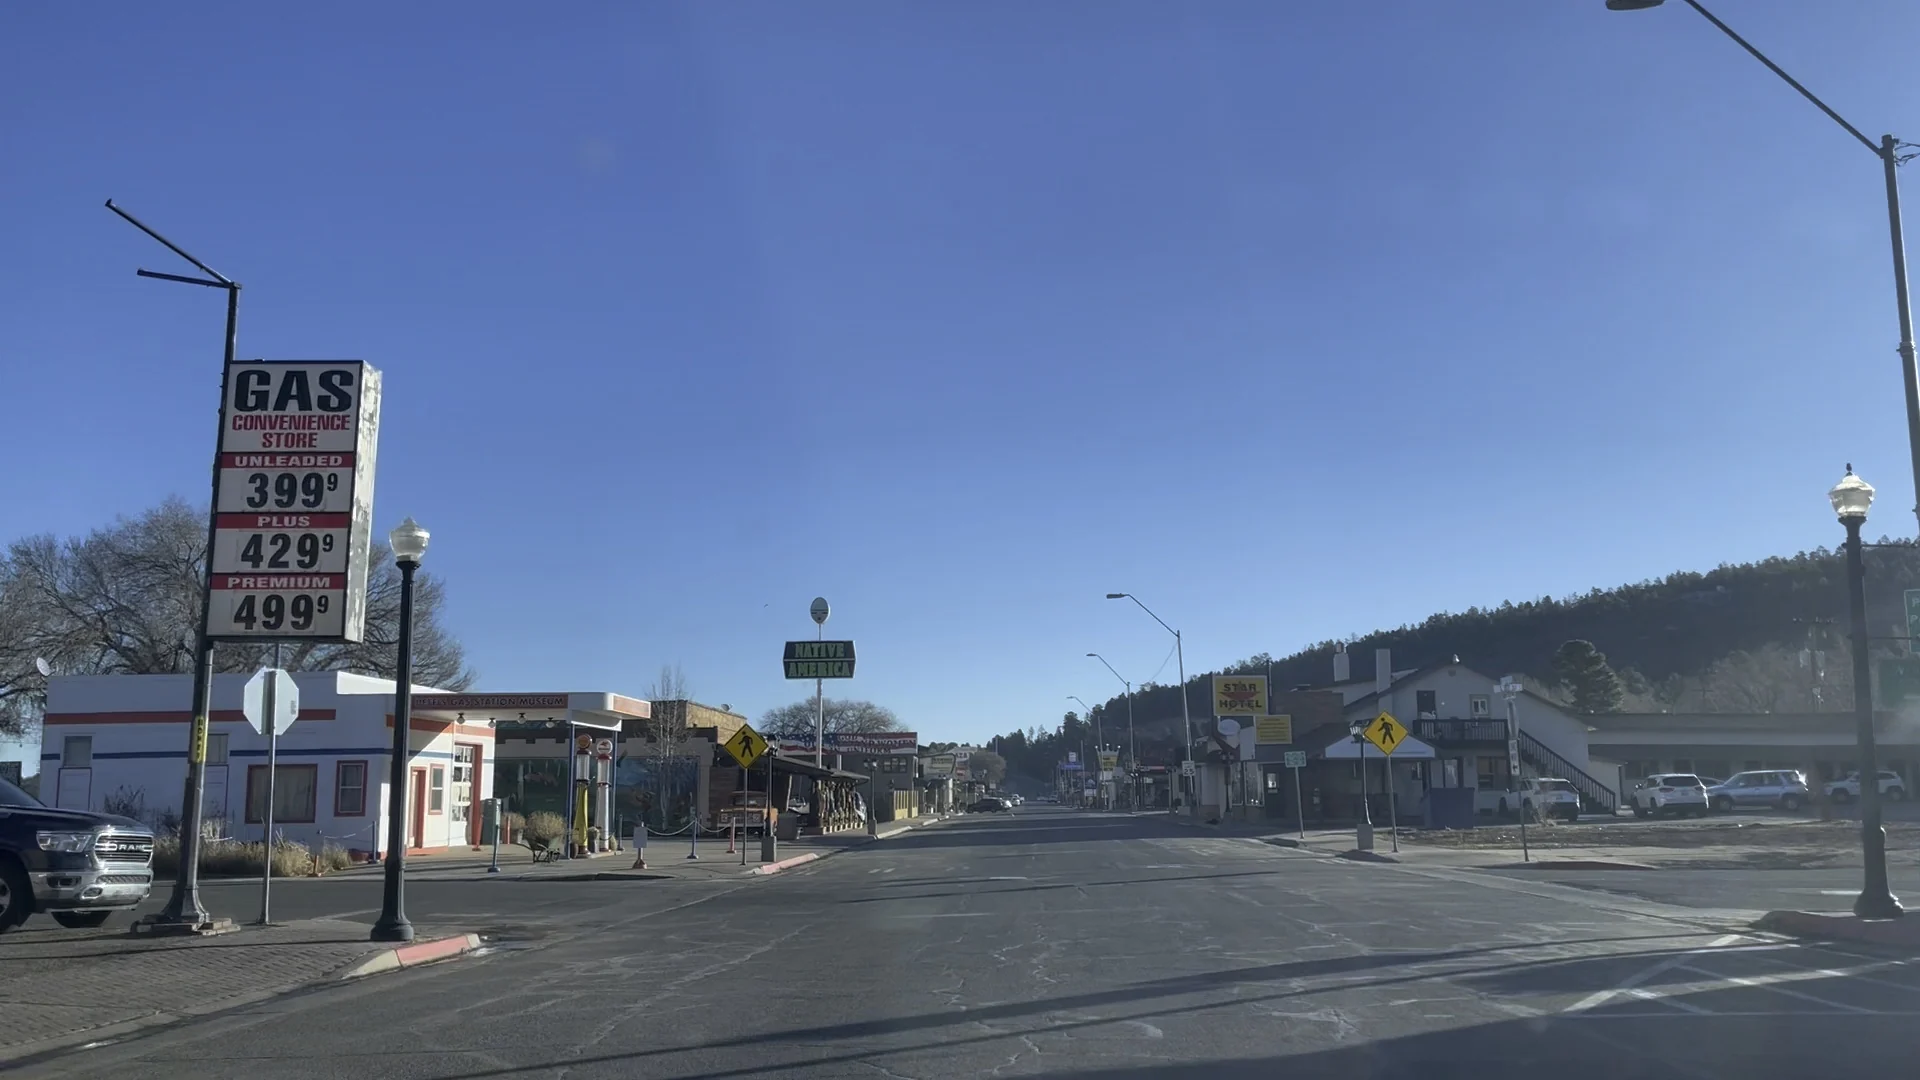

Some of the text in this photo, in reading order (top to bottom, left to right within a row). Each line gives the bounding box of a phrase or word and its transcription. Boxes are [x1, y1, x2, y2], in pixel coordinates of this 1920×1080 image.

[234, 369, 354, 412] GAS
[232, 414, 351, 431] CONVENIENCE
[261, 432, 318, 448] STORE
[235, 455, 343, 467] UNLEADED
[257, 516, 310, 528] PLUS
[227, 577, 330, 588] PREMIUM
[795, 643, 845, 658] NATIVE
[788, 662, 851, 677] AMERICA
[1223, 683, 1257, 692] STAR
[450, 698, 471, 706] GAS
[473, 697, 516, 706] STATION
[519, 697, 563, 705] MUSEUM
[1219, 700, 1262, 708] HOTEL
